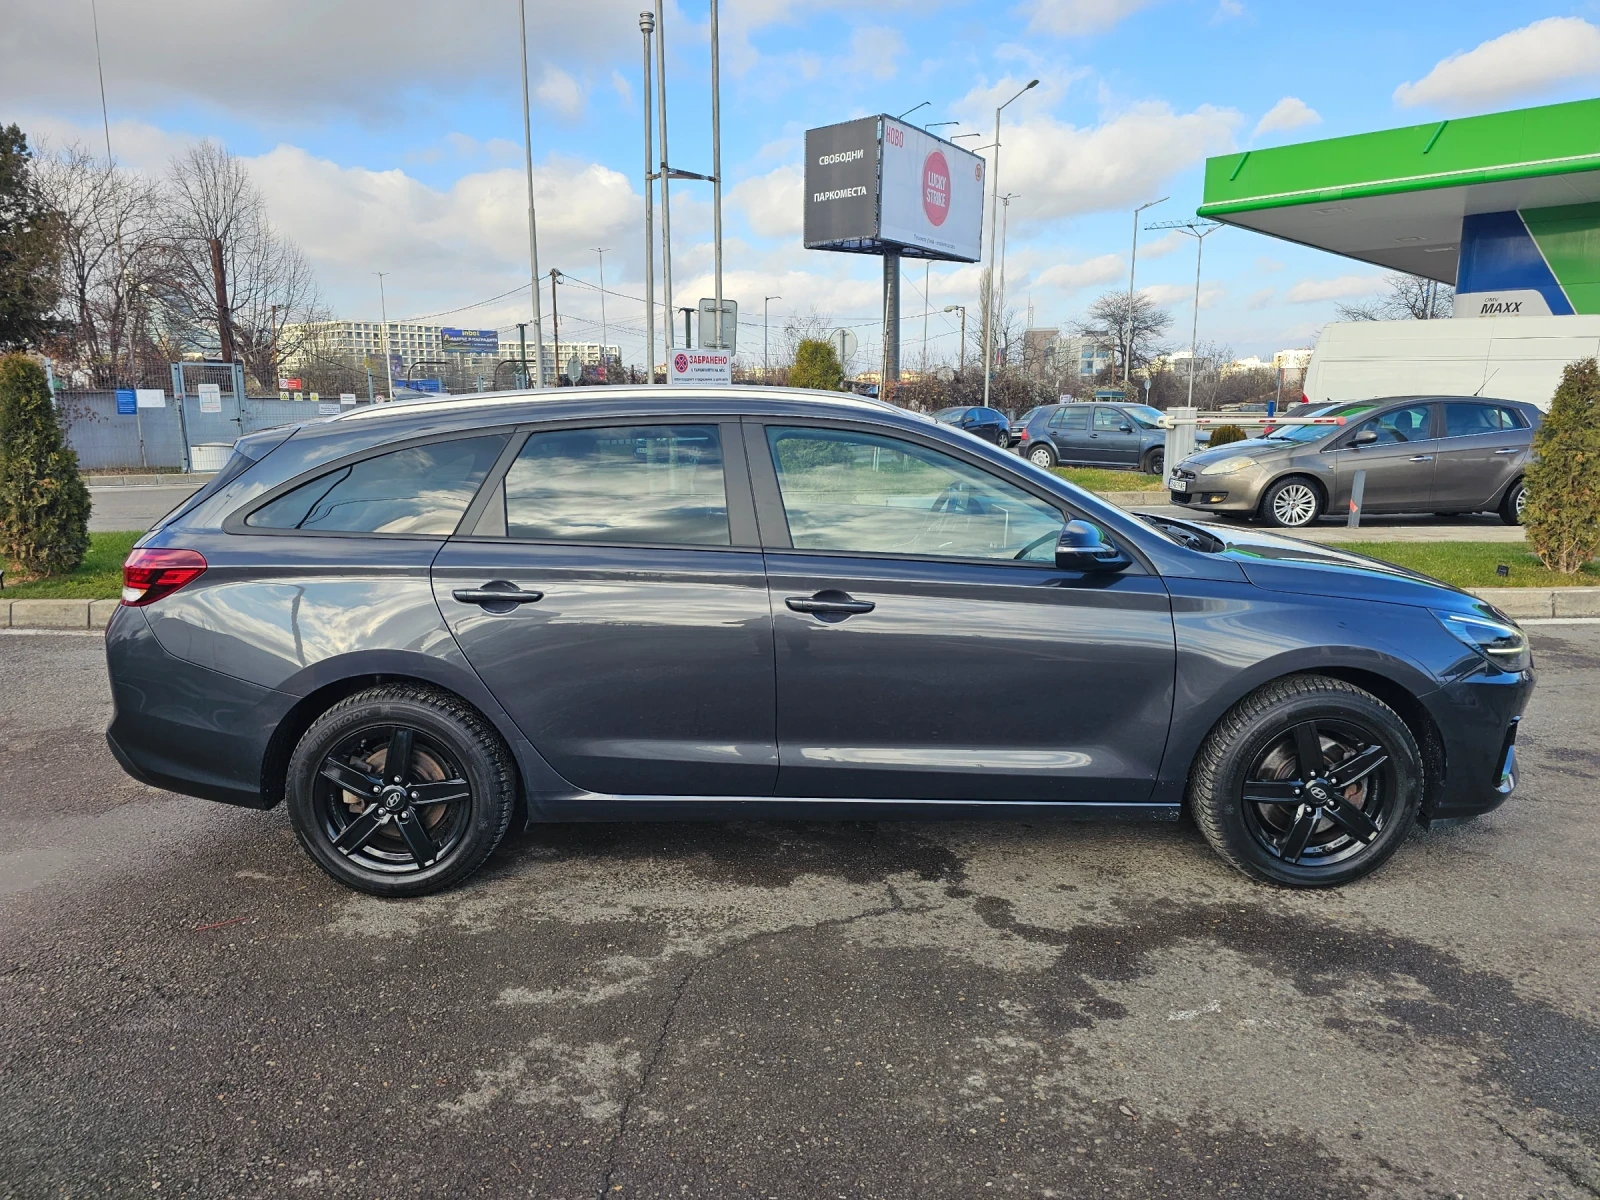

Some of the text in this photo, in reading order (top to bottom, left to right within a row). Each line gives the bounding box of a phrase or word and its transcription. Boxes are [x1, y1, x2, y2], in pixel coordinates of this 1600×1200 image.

[886, 125, 904, 148] НОВО
[819, 149, 864, 165] СВОБОДНИ
[928, 171, 947, 191] LUCKY
[814, 186, 867, 202] ПАРКОМЕСТА
[926, 188, 946, 208] STRIKE
[1480, 301, 1523, 314] MAXX
[689, 355, 728, 365] ЗАБРАНЕНО
